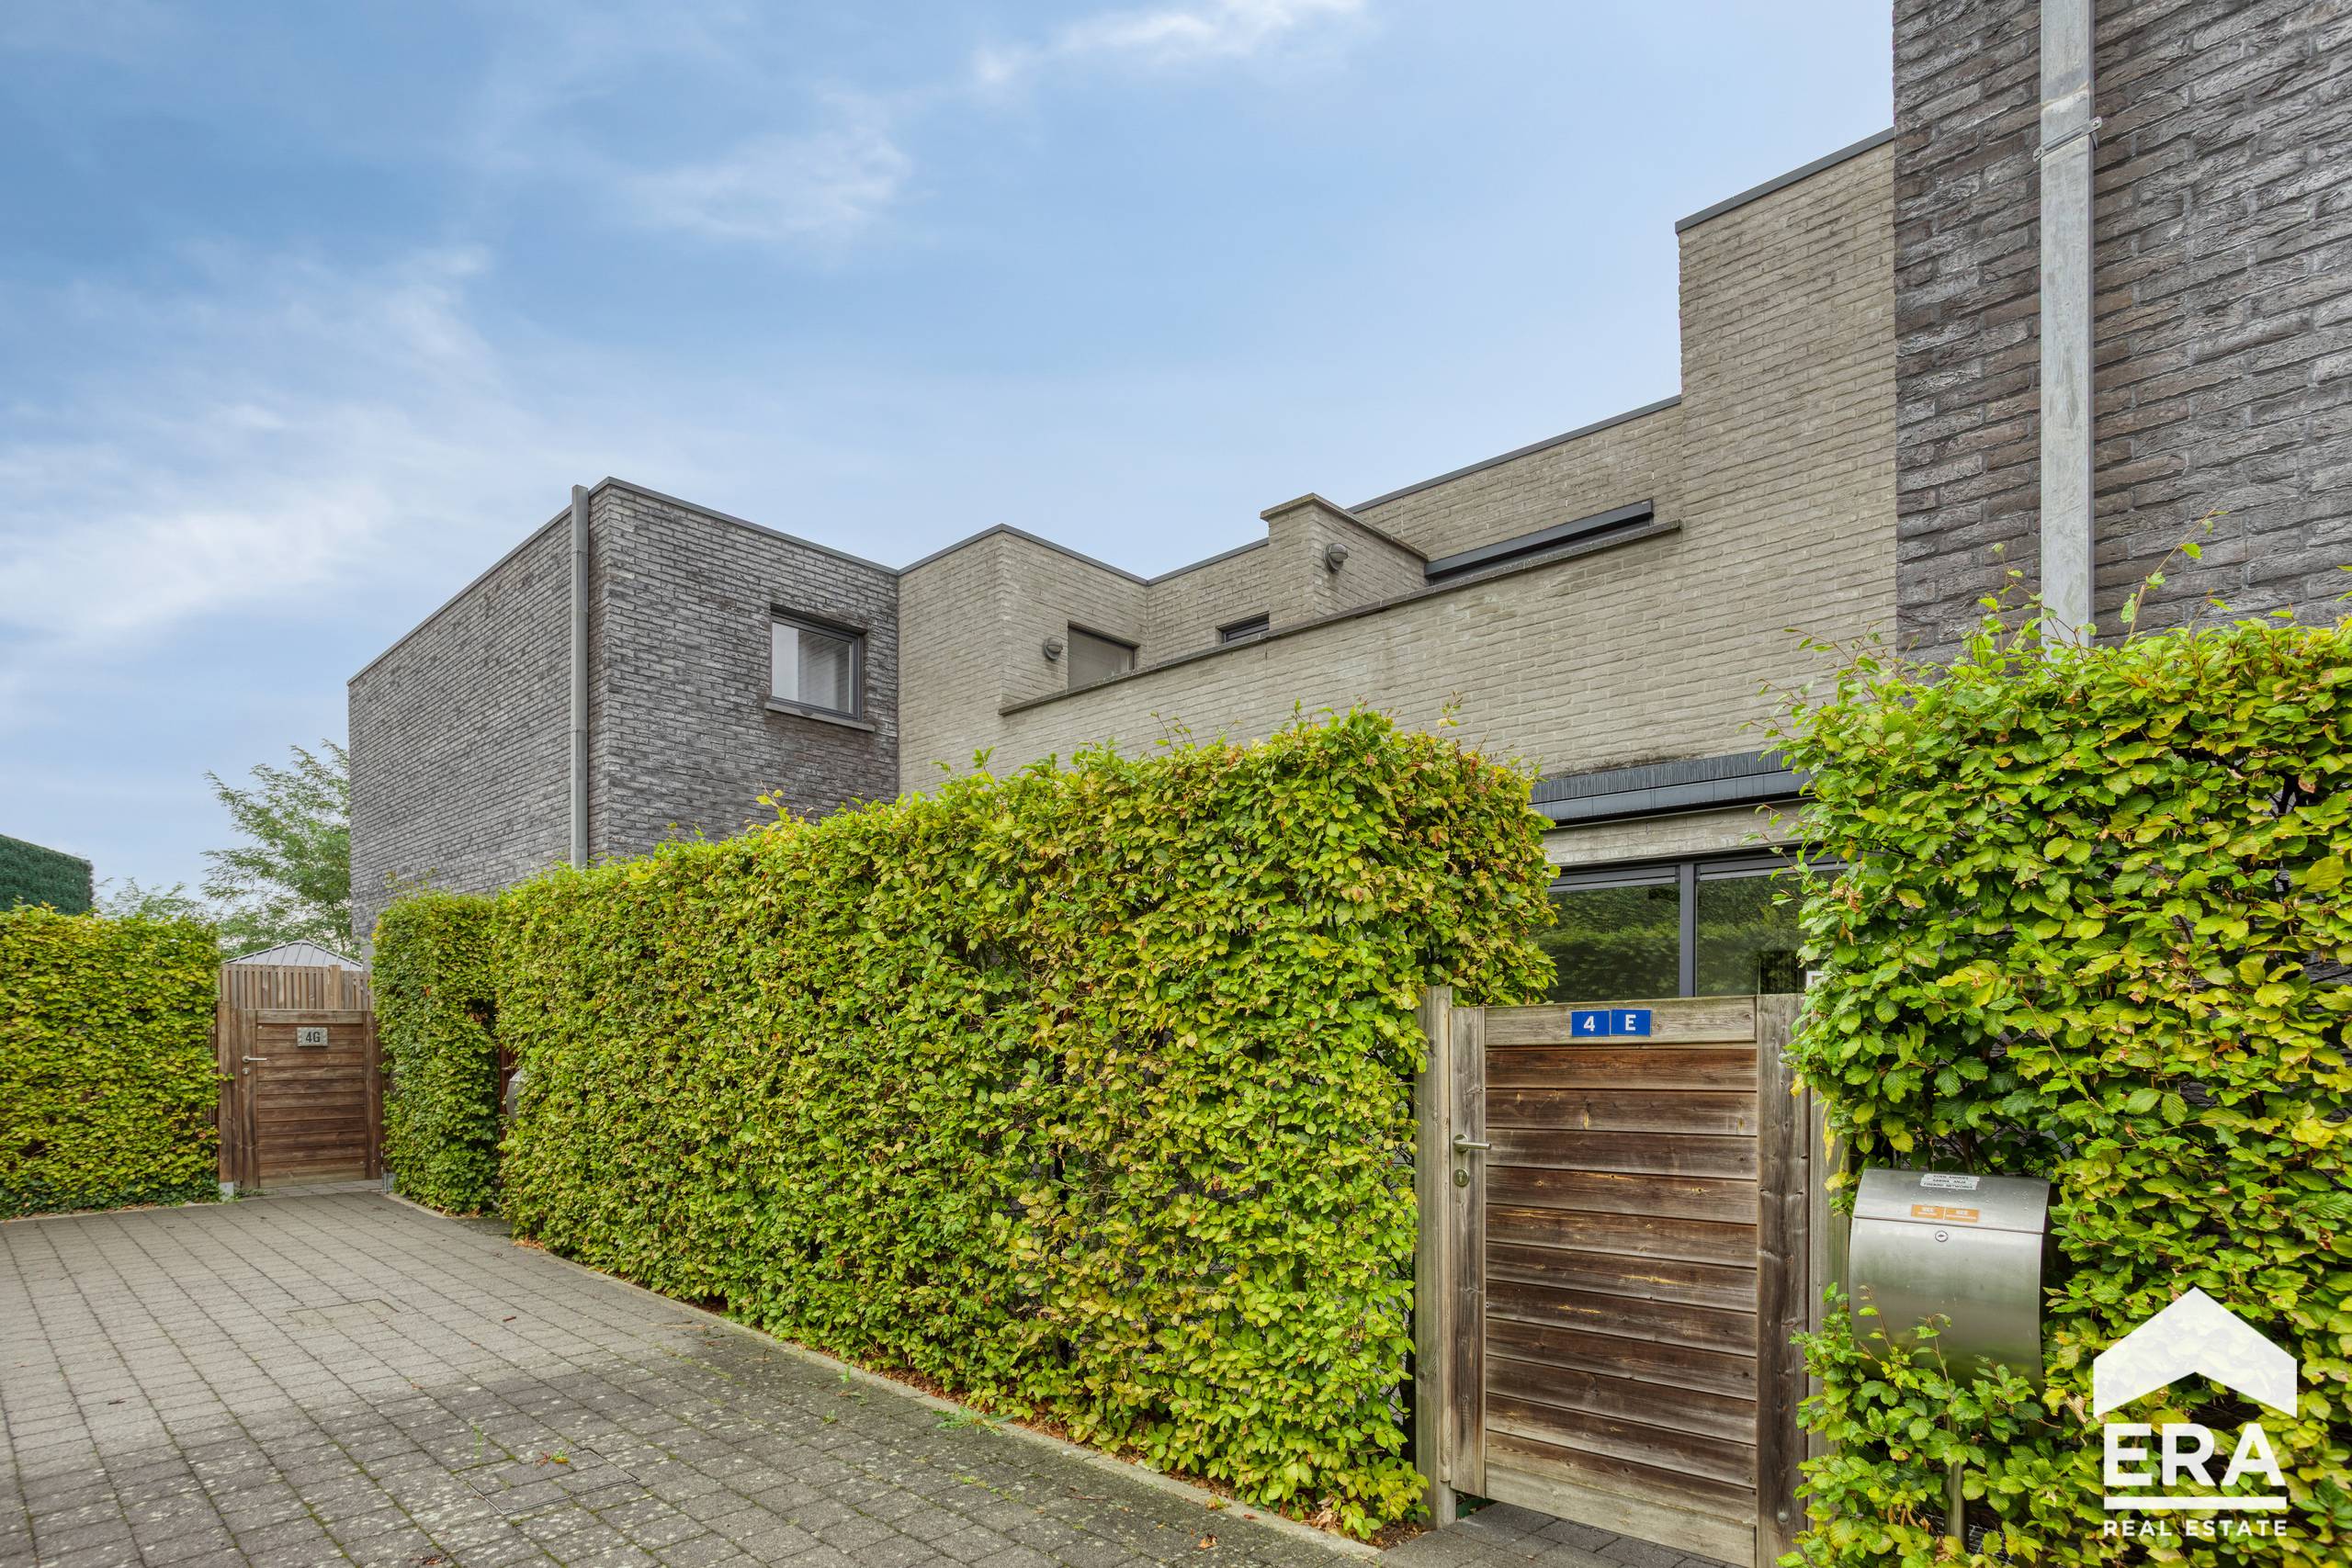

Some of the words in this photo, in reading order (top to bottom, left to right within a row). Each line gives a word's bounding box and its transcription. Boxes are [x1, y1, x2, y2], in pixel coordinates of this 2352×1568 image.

[1583, 1015, 1596, 1032] 4
[1624, 1014, 1636, 1032] E
[305, 1031, 321, 1043] 4G
